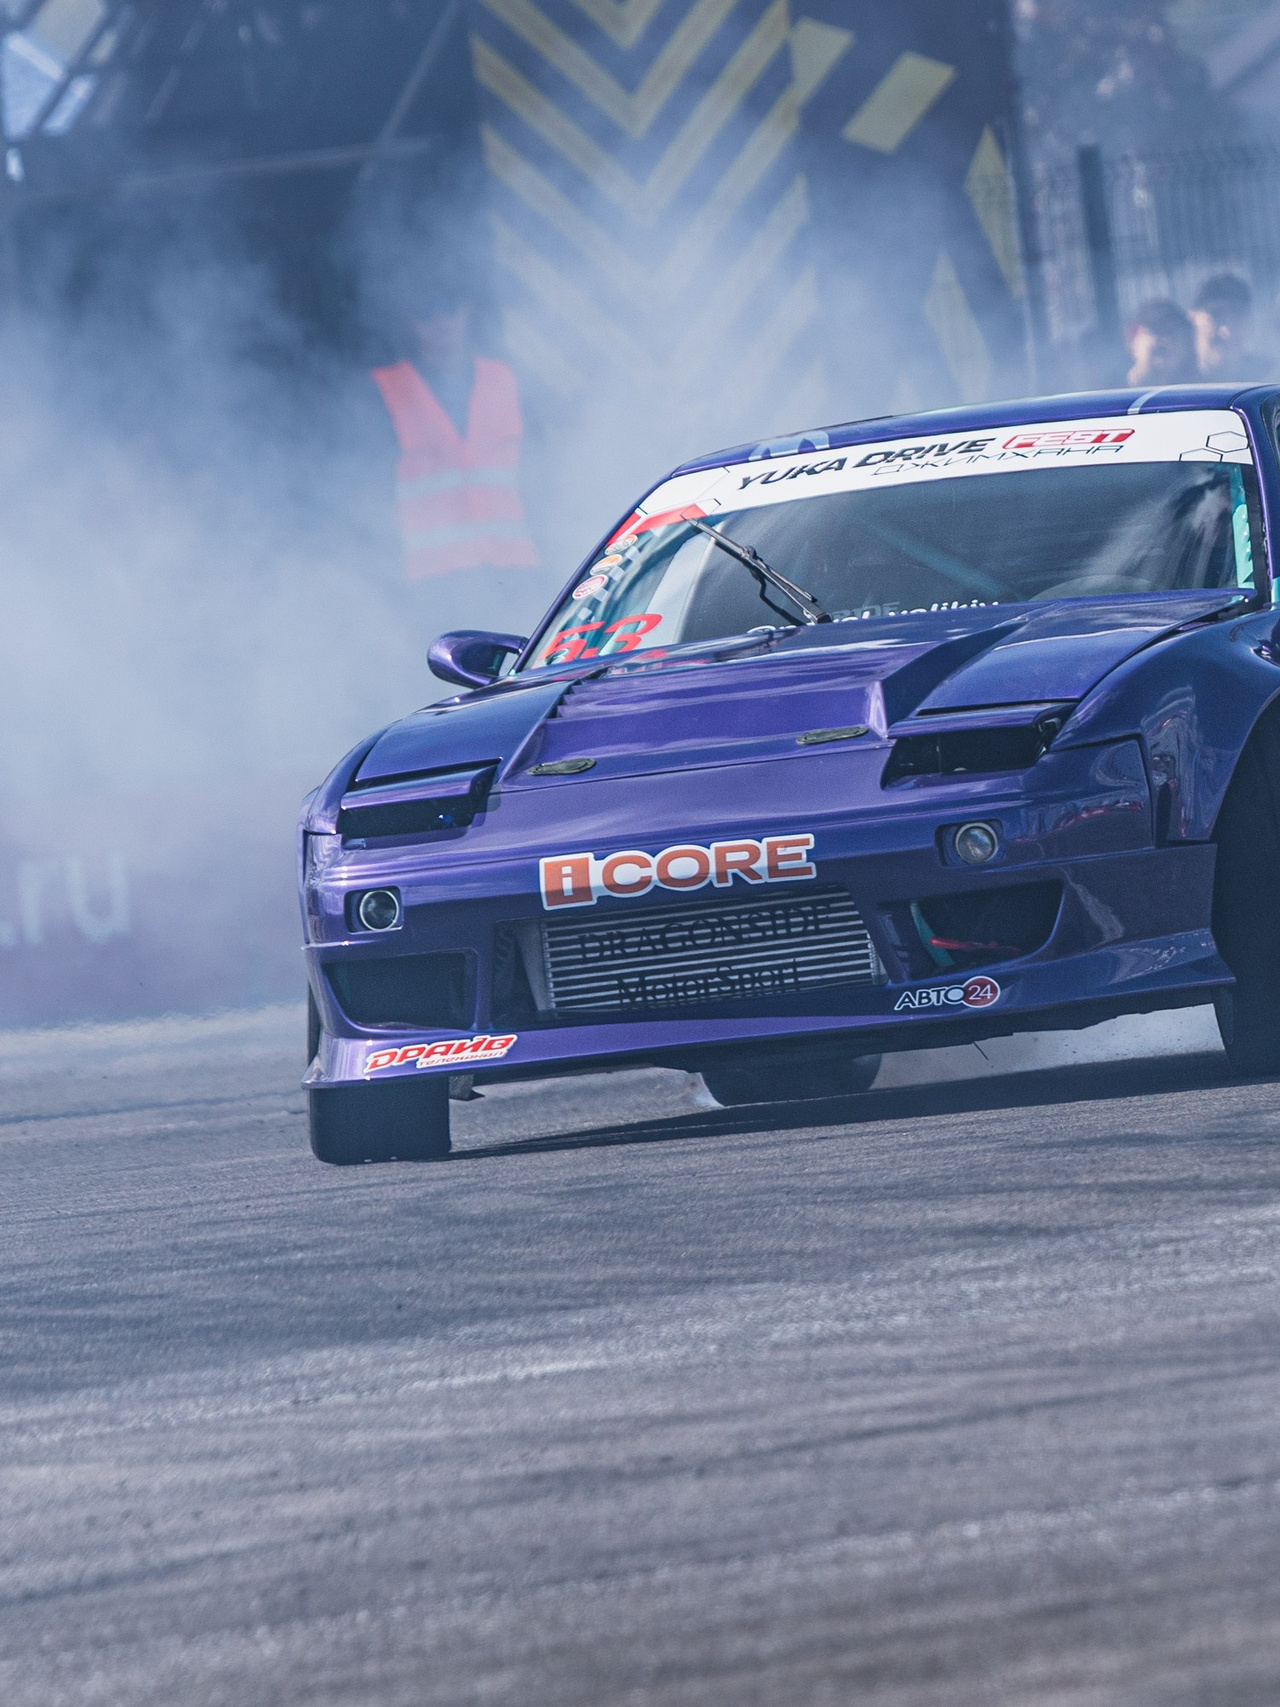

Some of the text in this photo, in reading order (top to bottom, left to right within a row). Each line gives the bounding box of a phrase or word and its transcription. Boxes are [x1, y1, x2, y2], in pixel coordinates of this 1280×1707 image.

[738, 429, 1135, 490] YUKA DRIVE FEST
[870, 445, 1124, 476] ДЖИМХАНА
[368, 1037, 515, 1071] ДРАЙВ
